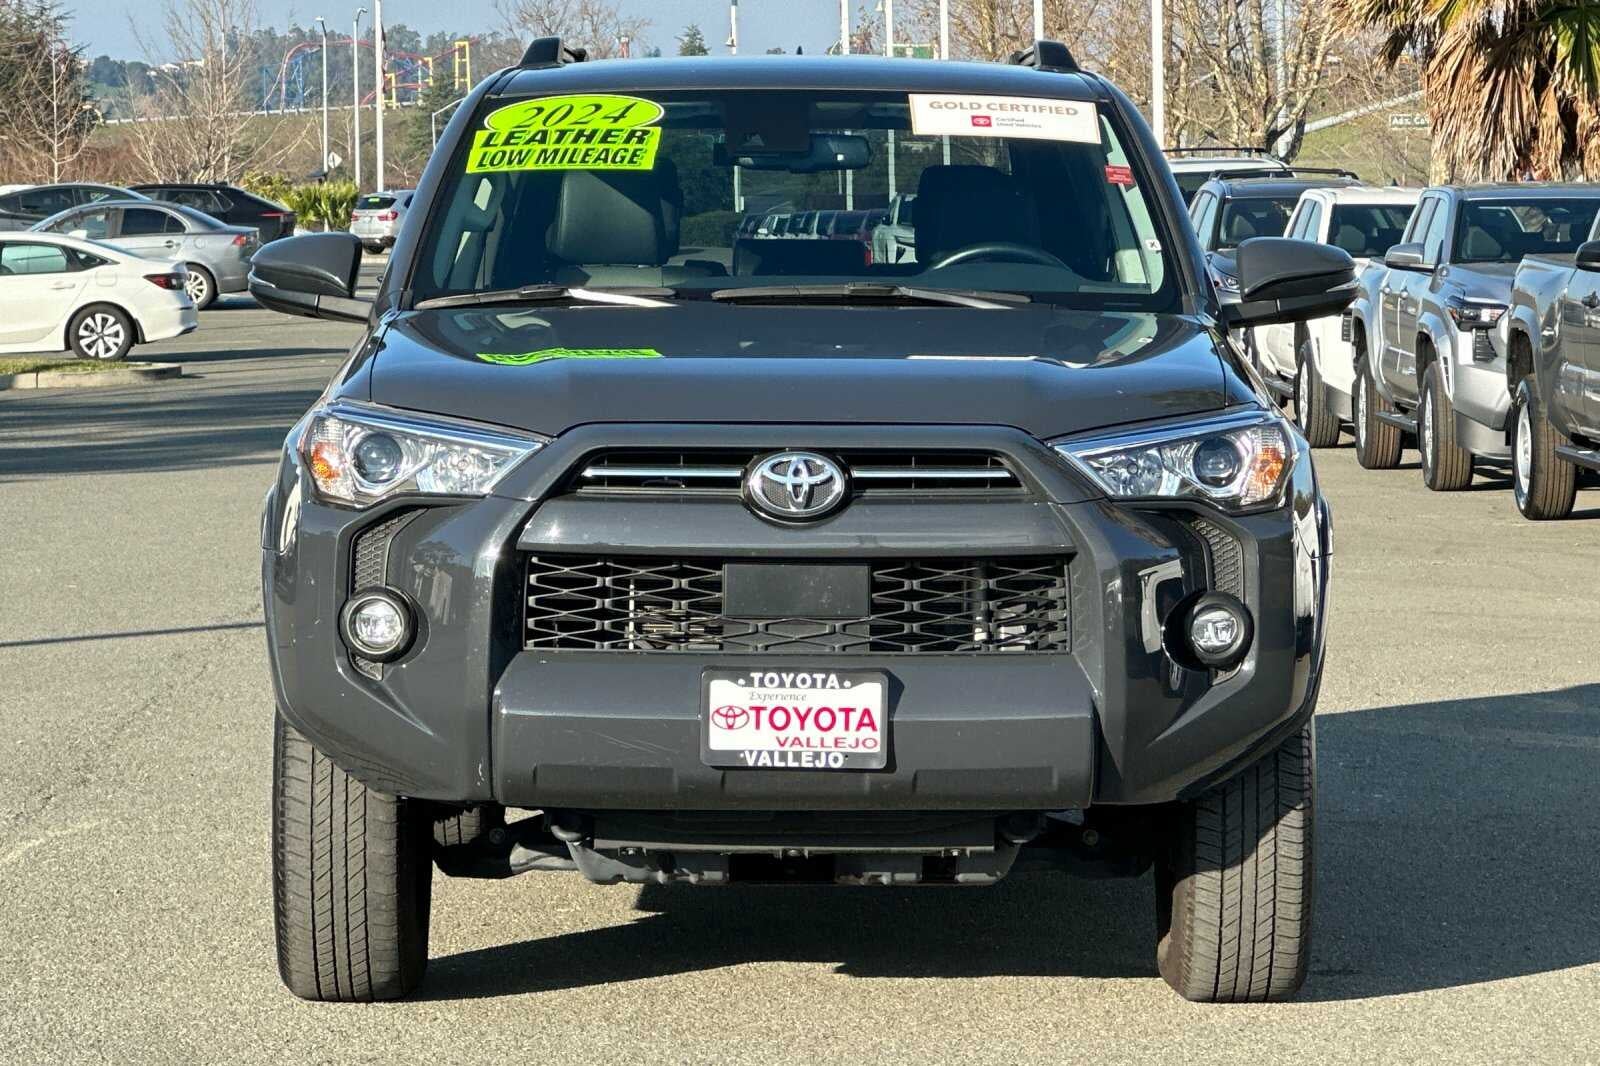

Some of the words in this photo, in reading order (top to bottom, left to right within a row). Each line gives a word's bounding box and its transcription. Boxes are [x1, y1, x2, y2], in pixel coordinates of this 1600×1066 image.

[514, 101, 639, 128] 2024
[929, 100, 982, 111] GOLD
[986, 102, 1079, 116] CERTIFIED
[480, 128, 654, 148] LEATHER
[476, 149, 532, 168] LOW
[534, 148, 644, 166] MILEAGE
[749, 672, 840, 689] TOYOTA
[749, 691, 807, 703] Experience
[748, 705, 878, 732] TOYOTA
[776, 736, 878, 749] VALLEJO
[743, 750, 845, 768] VALLEJO
